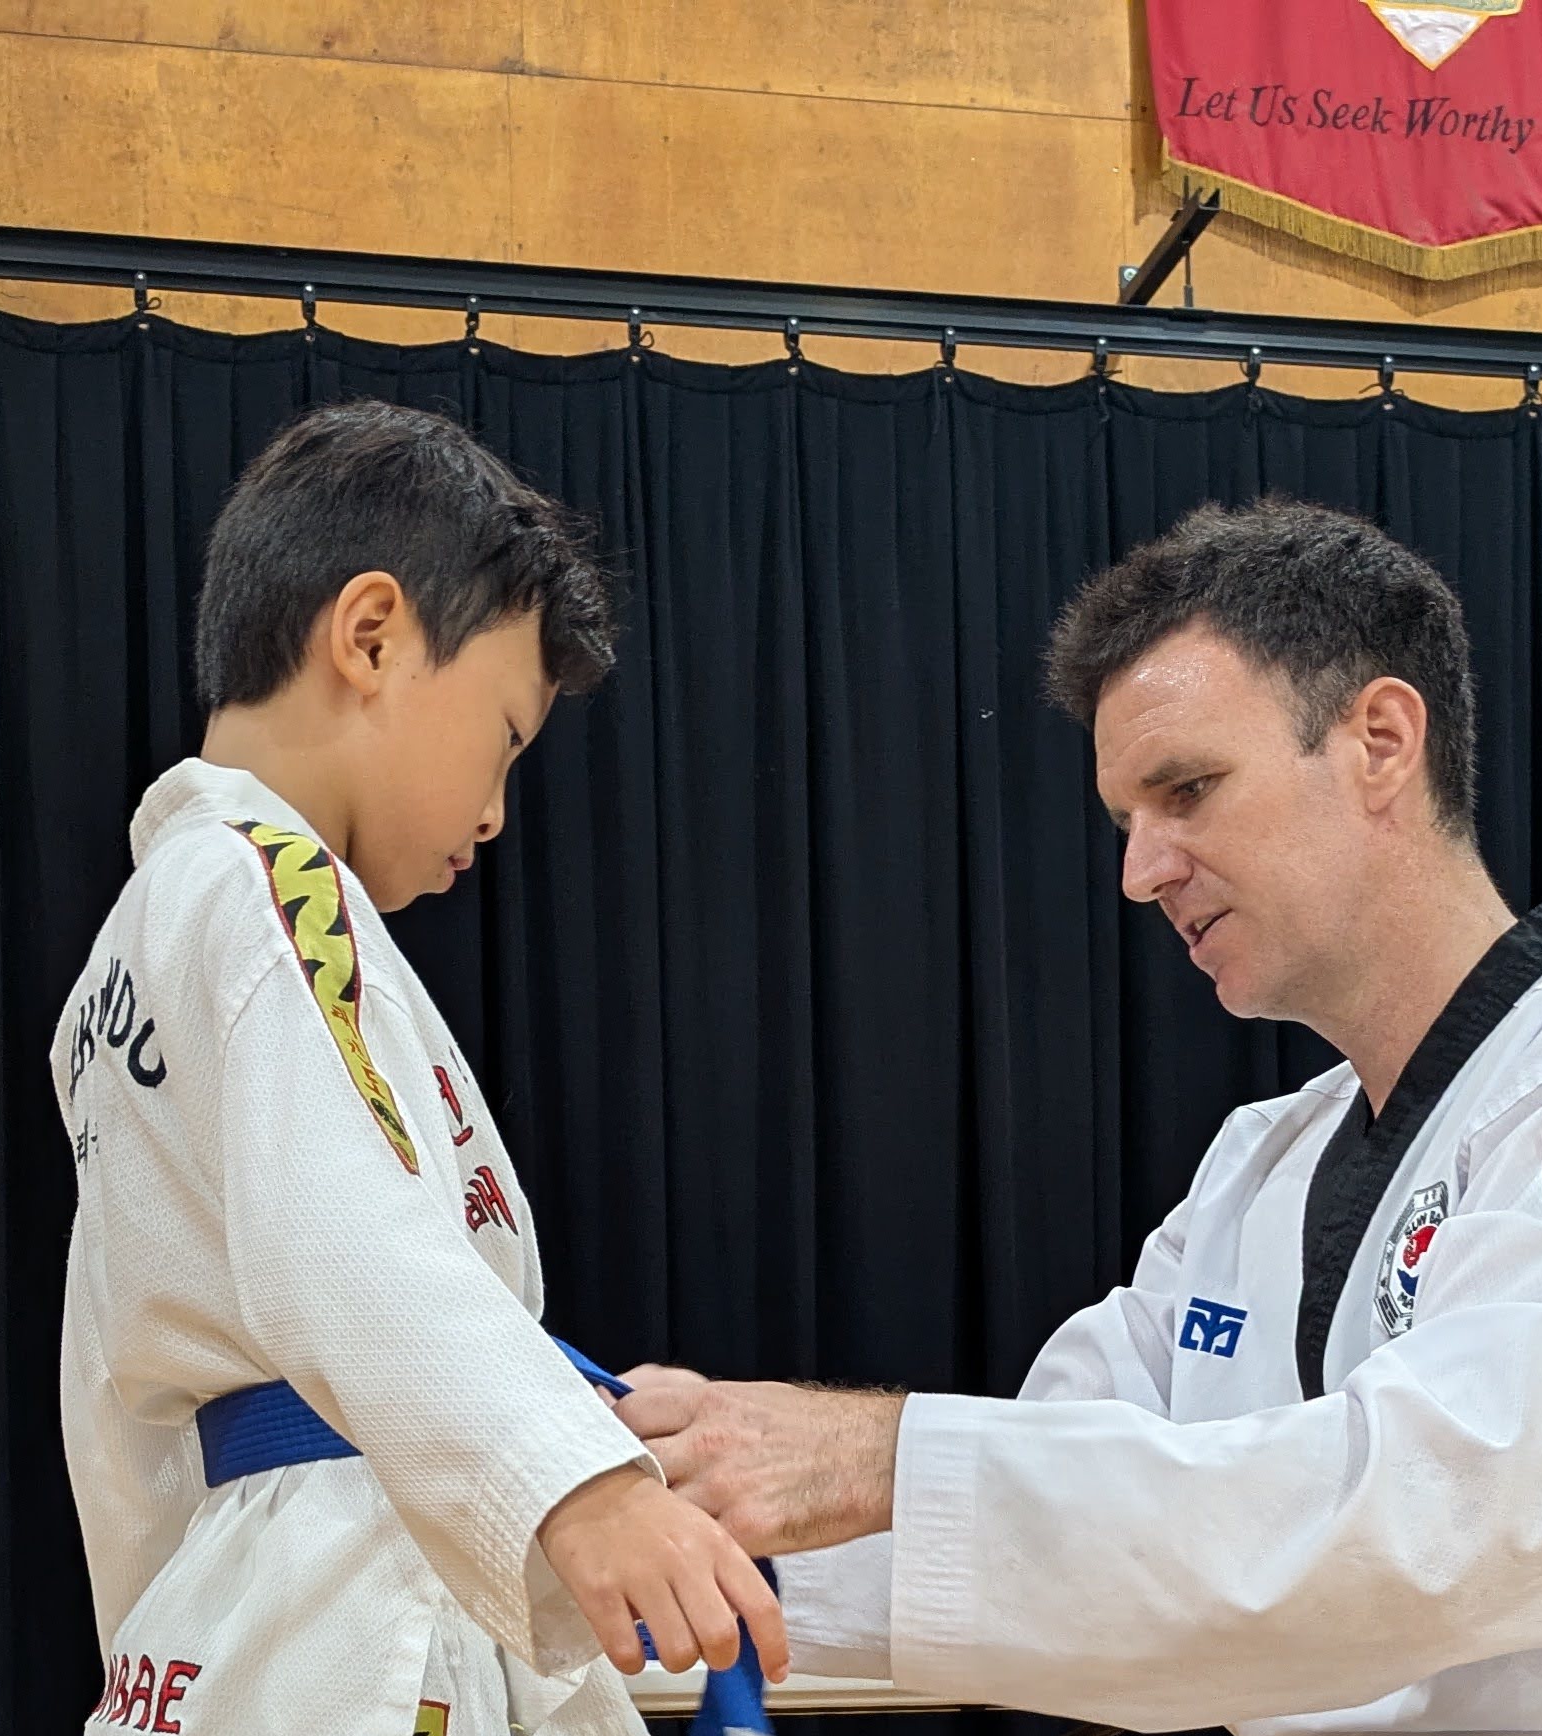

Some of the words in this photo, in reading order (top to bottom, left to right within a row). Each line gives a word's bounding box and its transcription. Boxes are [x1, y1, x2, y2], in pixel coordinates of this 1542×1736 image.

[1176, 77, 1237, 122] Let
[1249, 84, 1299, 127] Us
[1307, 88, 1394, 134] Seek
[1403, 96, 1536, 155] Worthy
